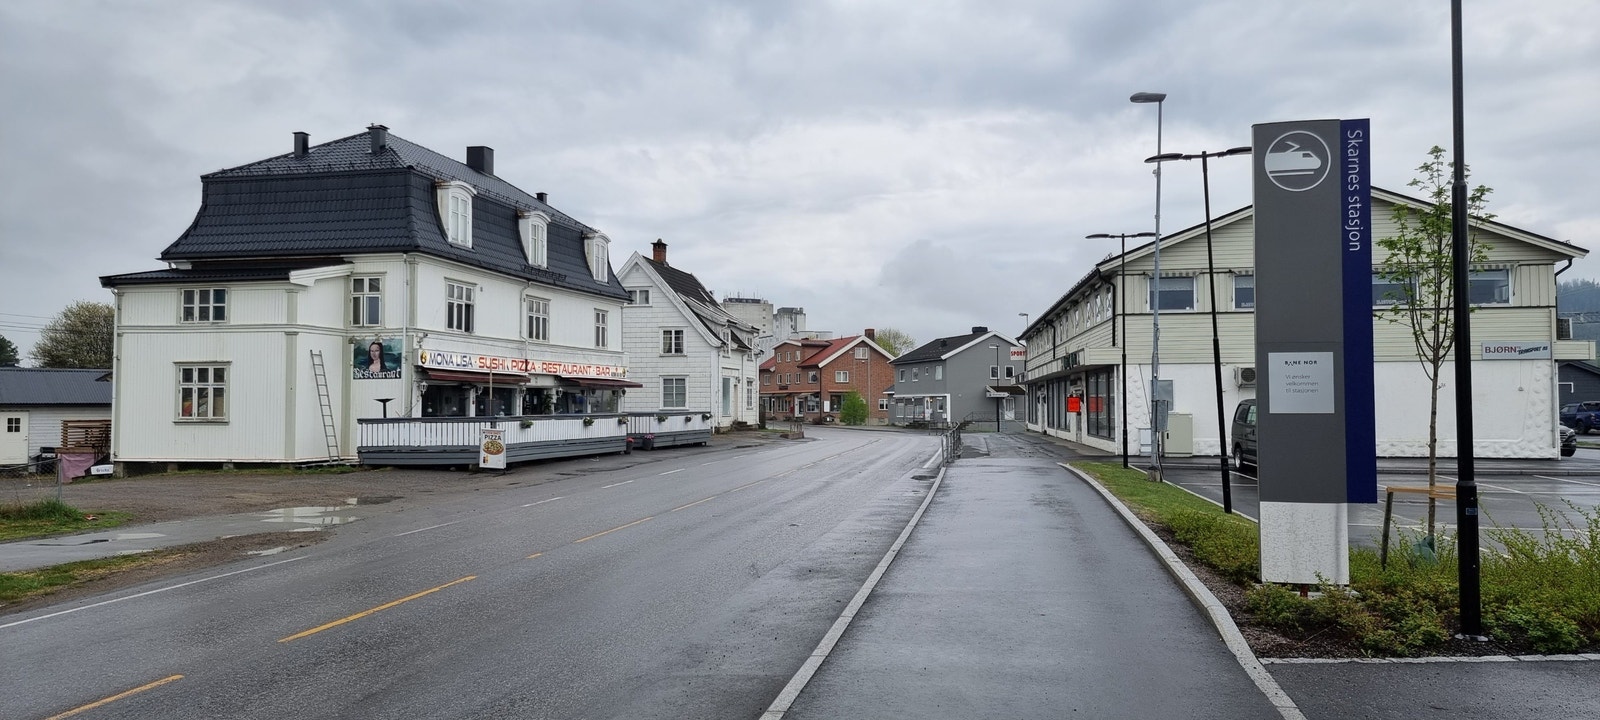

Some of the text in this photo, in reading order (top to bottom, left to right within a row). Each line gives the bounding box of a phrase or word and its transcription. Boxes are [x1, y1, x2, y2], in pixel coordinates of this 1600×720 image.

[1345, 129, 1364, 251] Skarnes stasjon
[353, 367, 401, 379] Restaurant
[428, 353, 454, 367] MONA
[456, 355, 473, 368] LISA
[478, 356, 506, 370] SUSHI
[511, 359, 536, 372] PIZZA
[541, 362, 592, 375] RESTAURANT
[595, 366, 611, 376] BAR
